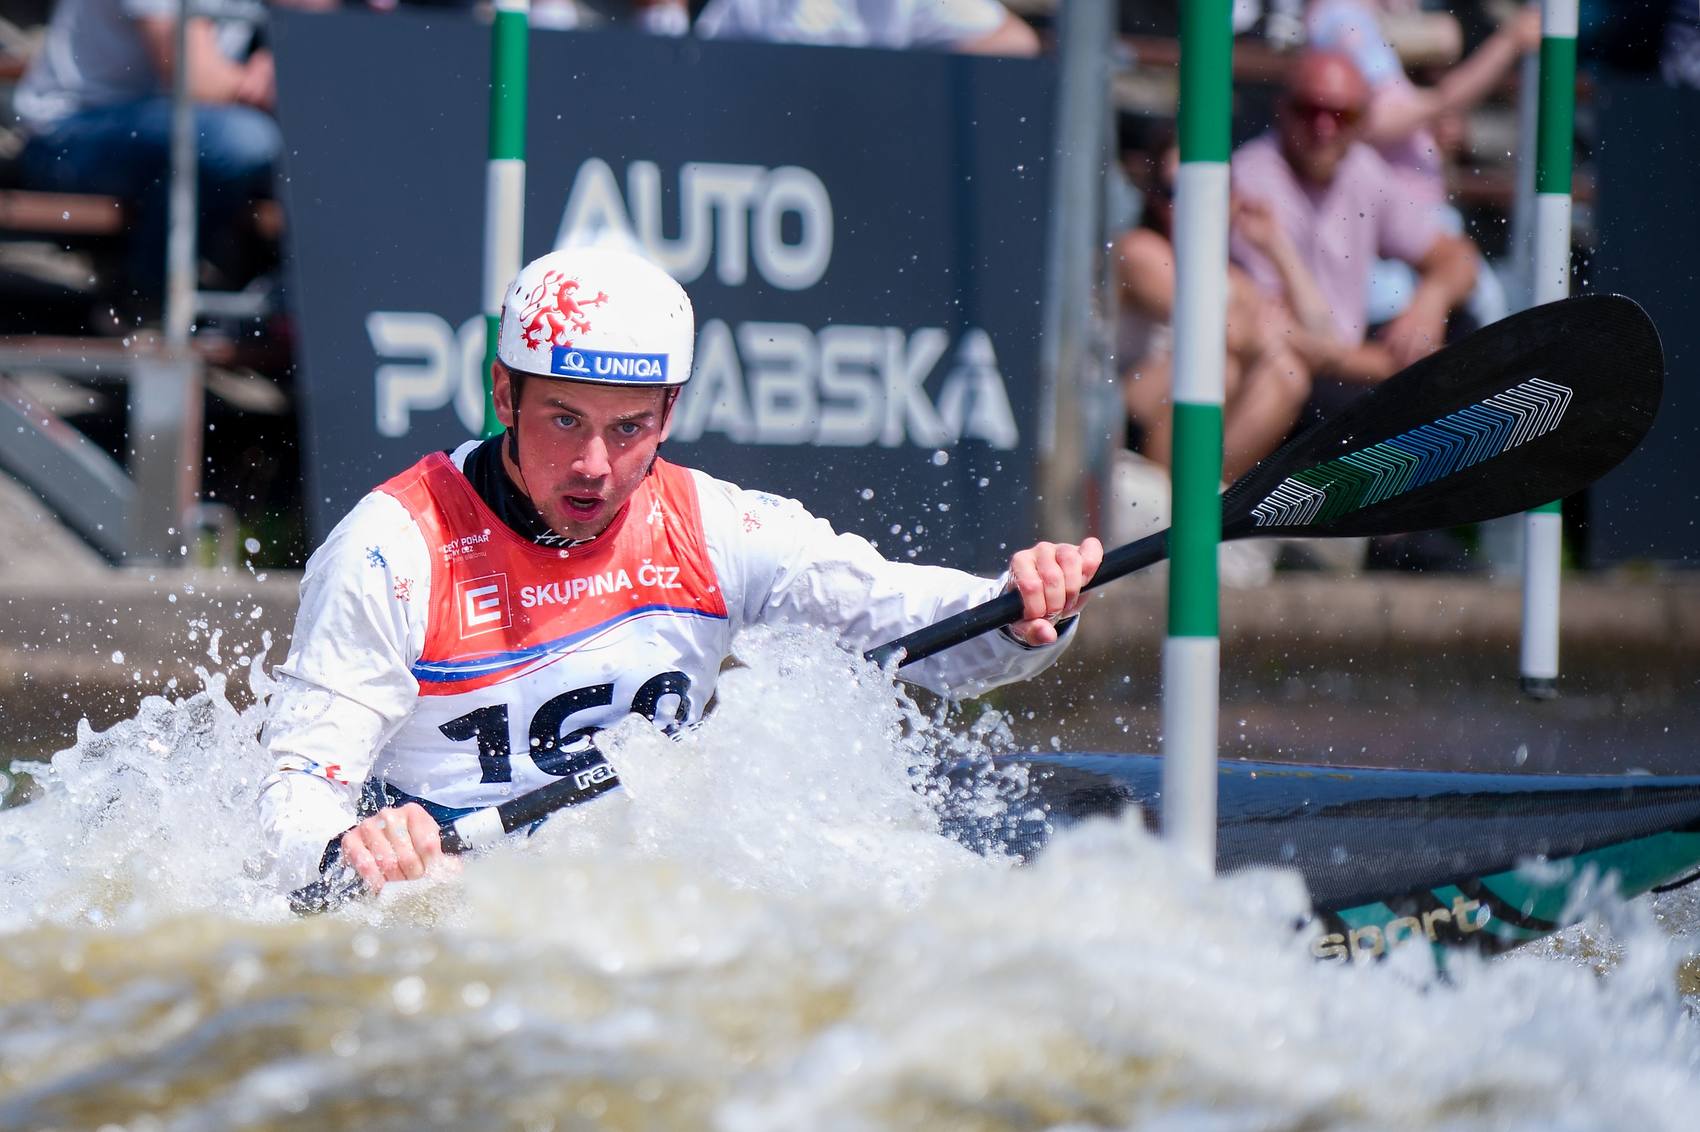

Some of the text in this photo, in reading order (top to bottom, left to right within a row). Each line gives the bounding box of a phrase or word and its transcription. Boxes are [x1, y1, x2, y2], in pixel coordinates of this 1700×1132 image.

[555, 157, 834, 290] AUTO
[594, 356, 663, 377] UNIQA
[520, 568, 634, 608] SKUPINA
[1310, 896, 1481, 962] sport
